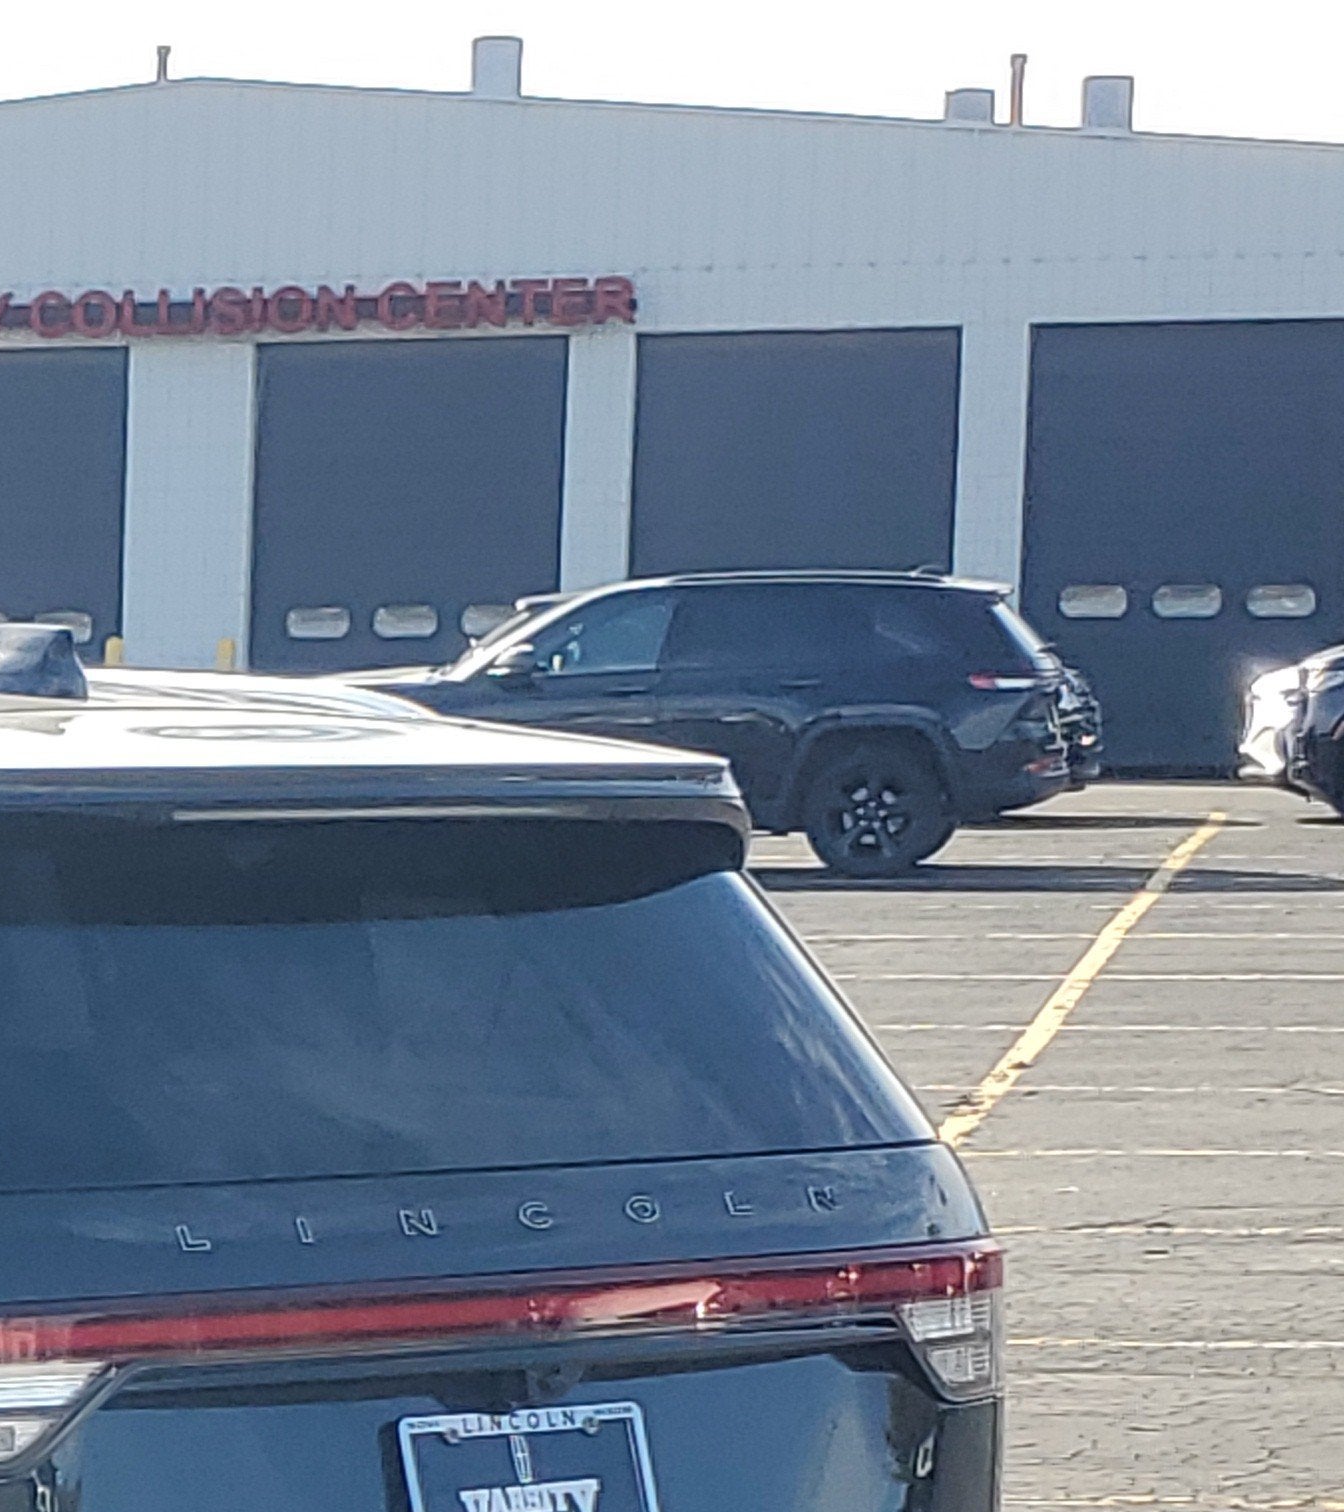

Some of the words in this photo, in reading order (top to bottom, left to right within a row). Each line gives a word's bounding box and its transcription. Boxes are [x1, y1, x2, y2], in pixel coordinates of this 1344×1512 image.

[31, 284, 356, 338] COLLISION
[378, 276, 637, 330] CENTER
[175, 1185, 843, 1251] LINCOLN
[462, 1411, 576, 1434] LINCOLN
